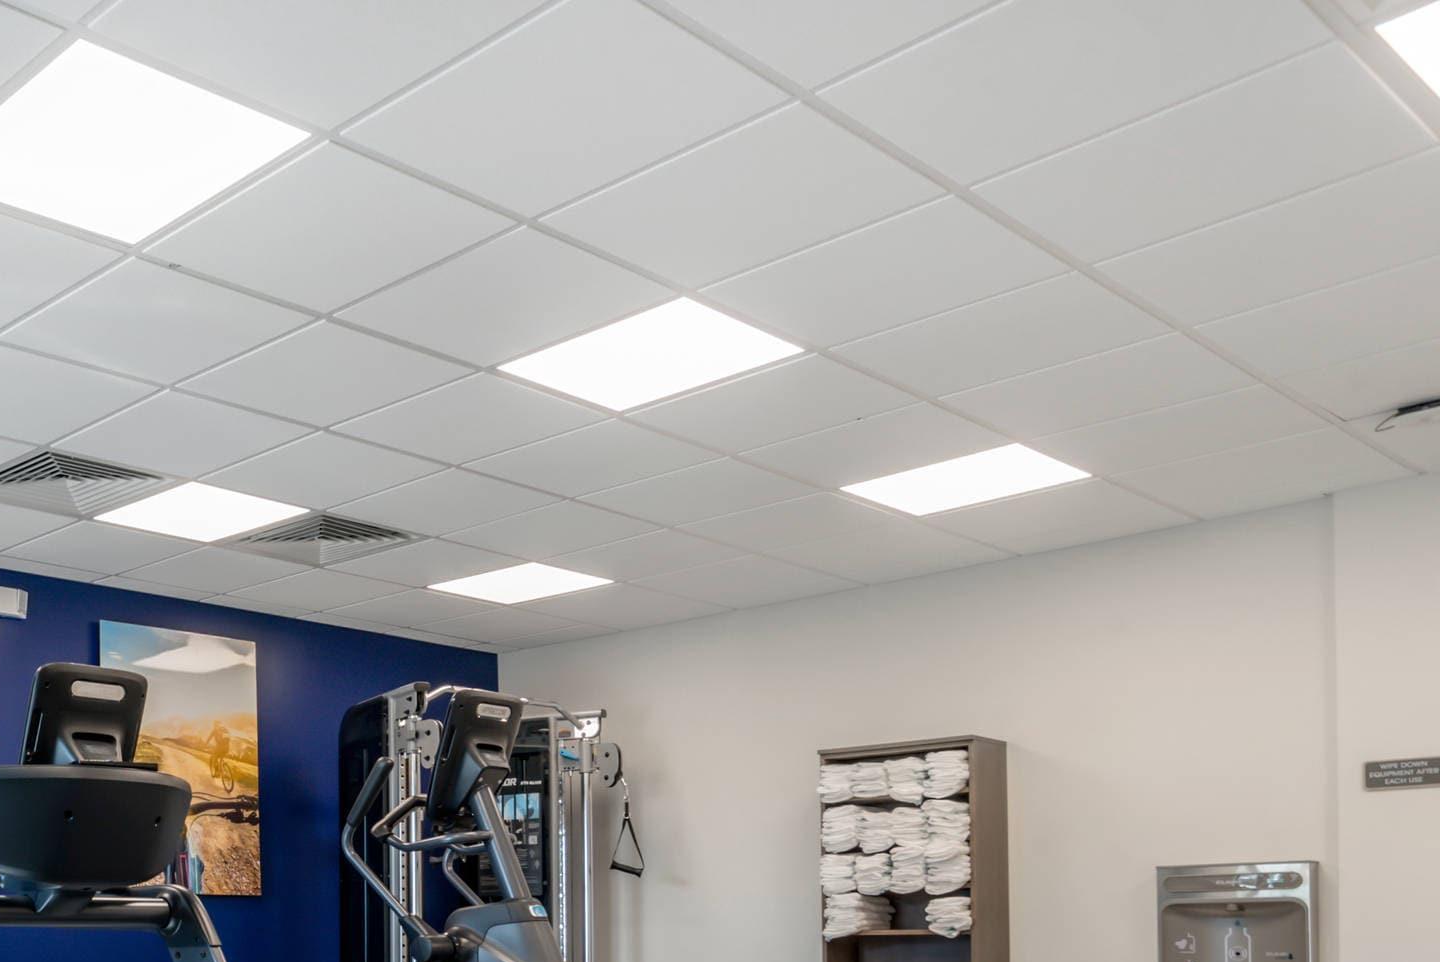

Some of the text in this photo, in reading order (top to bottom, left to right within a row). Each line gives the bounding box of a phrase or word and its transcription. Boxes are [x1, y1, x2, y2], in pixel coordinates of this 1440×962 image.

[1400, 761, 1428, 769] DOWN
[1368, 769, 1414, 778] EQUIPMENT
[1384, 775, 1423, 785] EACH USE
